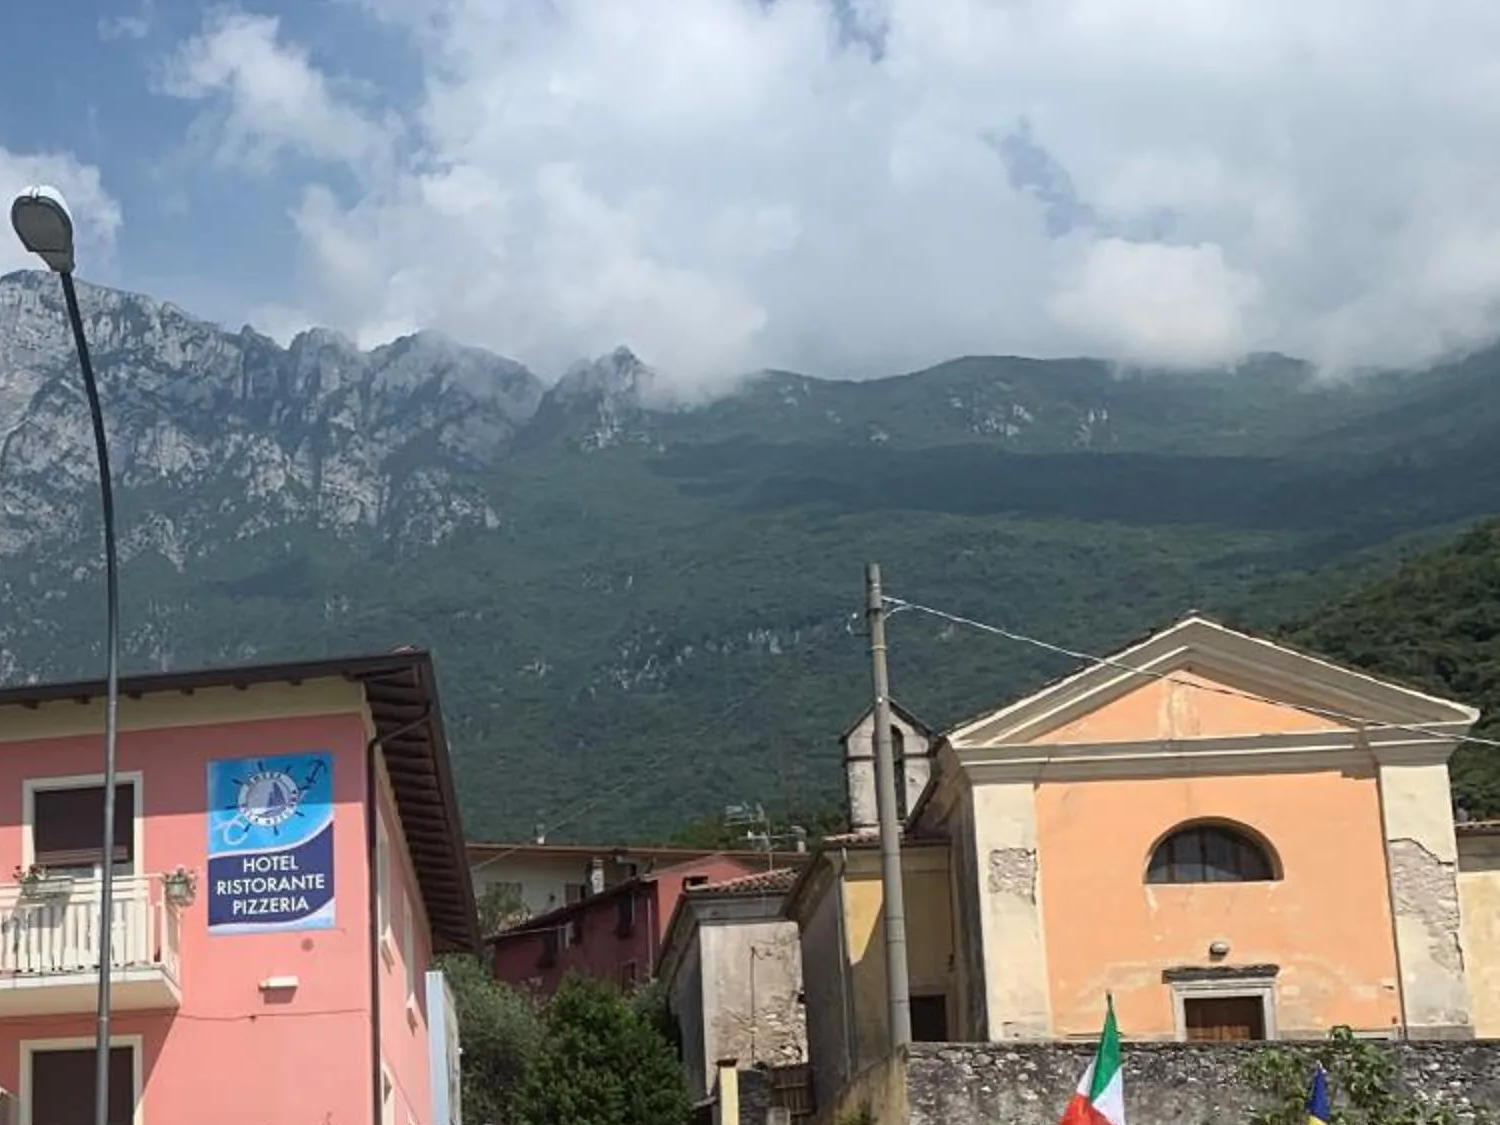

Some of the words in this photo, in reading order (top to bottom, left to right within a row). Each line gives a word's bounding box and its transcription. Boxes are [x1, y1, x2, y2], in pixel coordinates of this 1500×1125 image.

[243, 856, 299, 873] HOTEL
[217, 874, 325, 895] RISTORANTE
[233, 896, 309, 915] PIZZERIA
